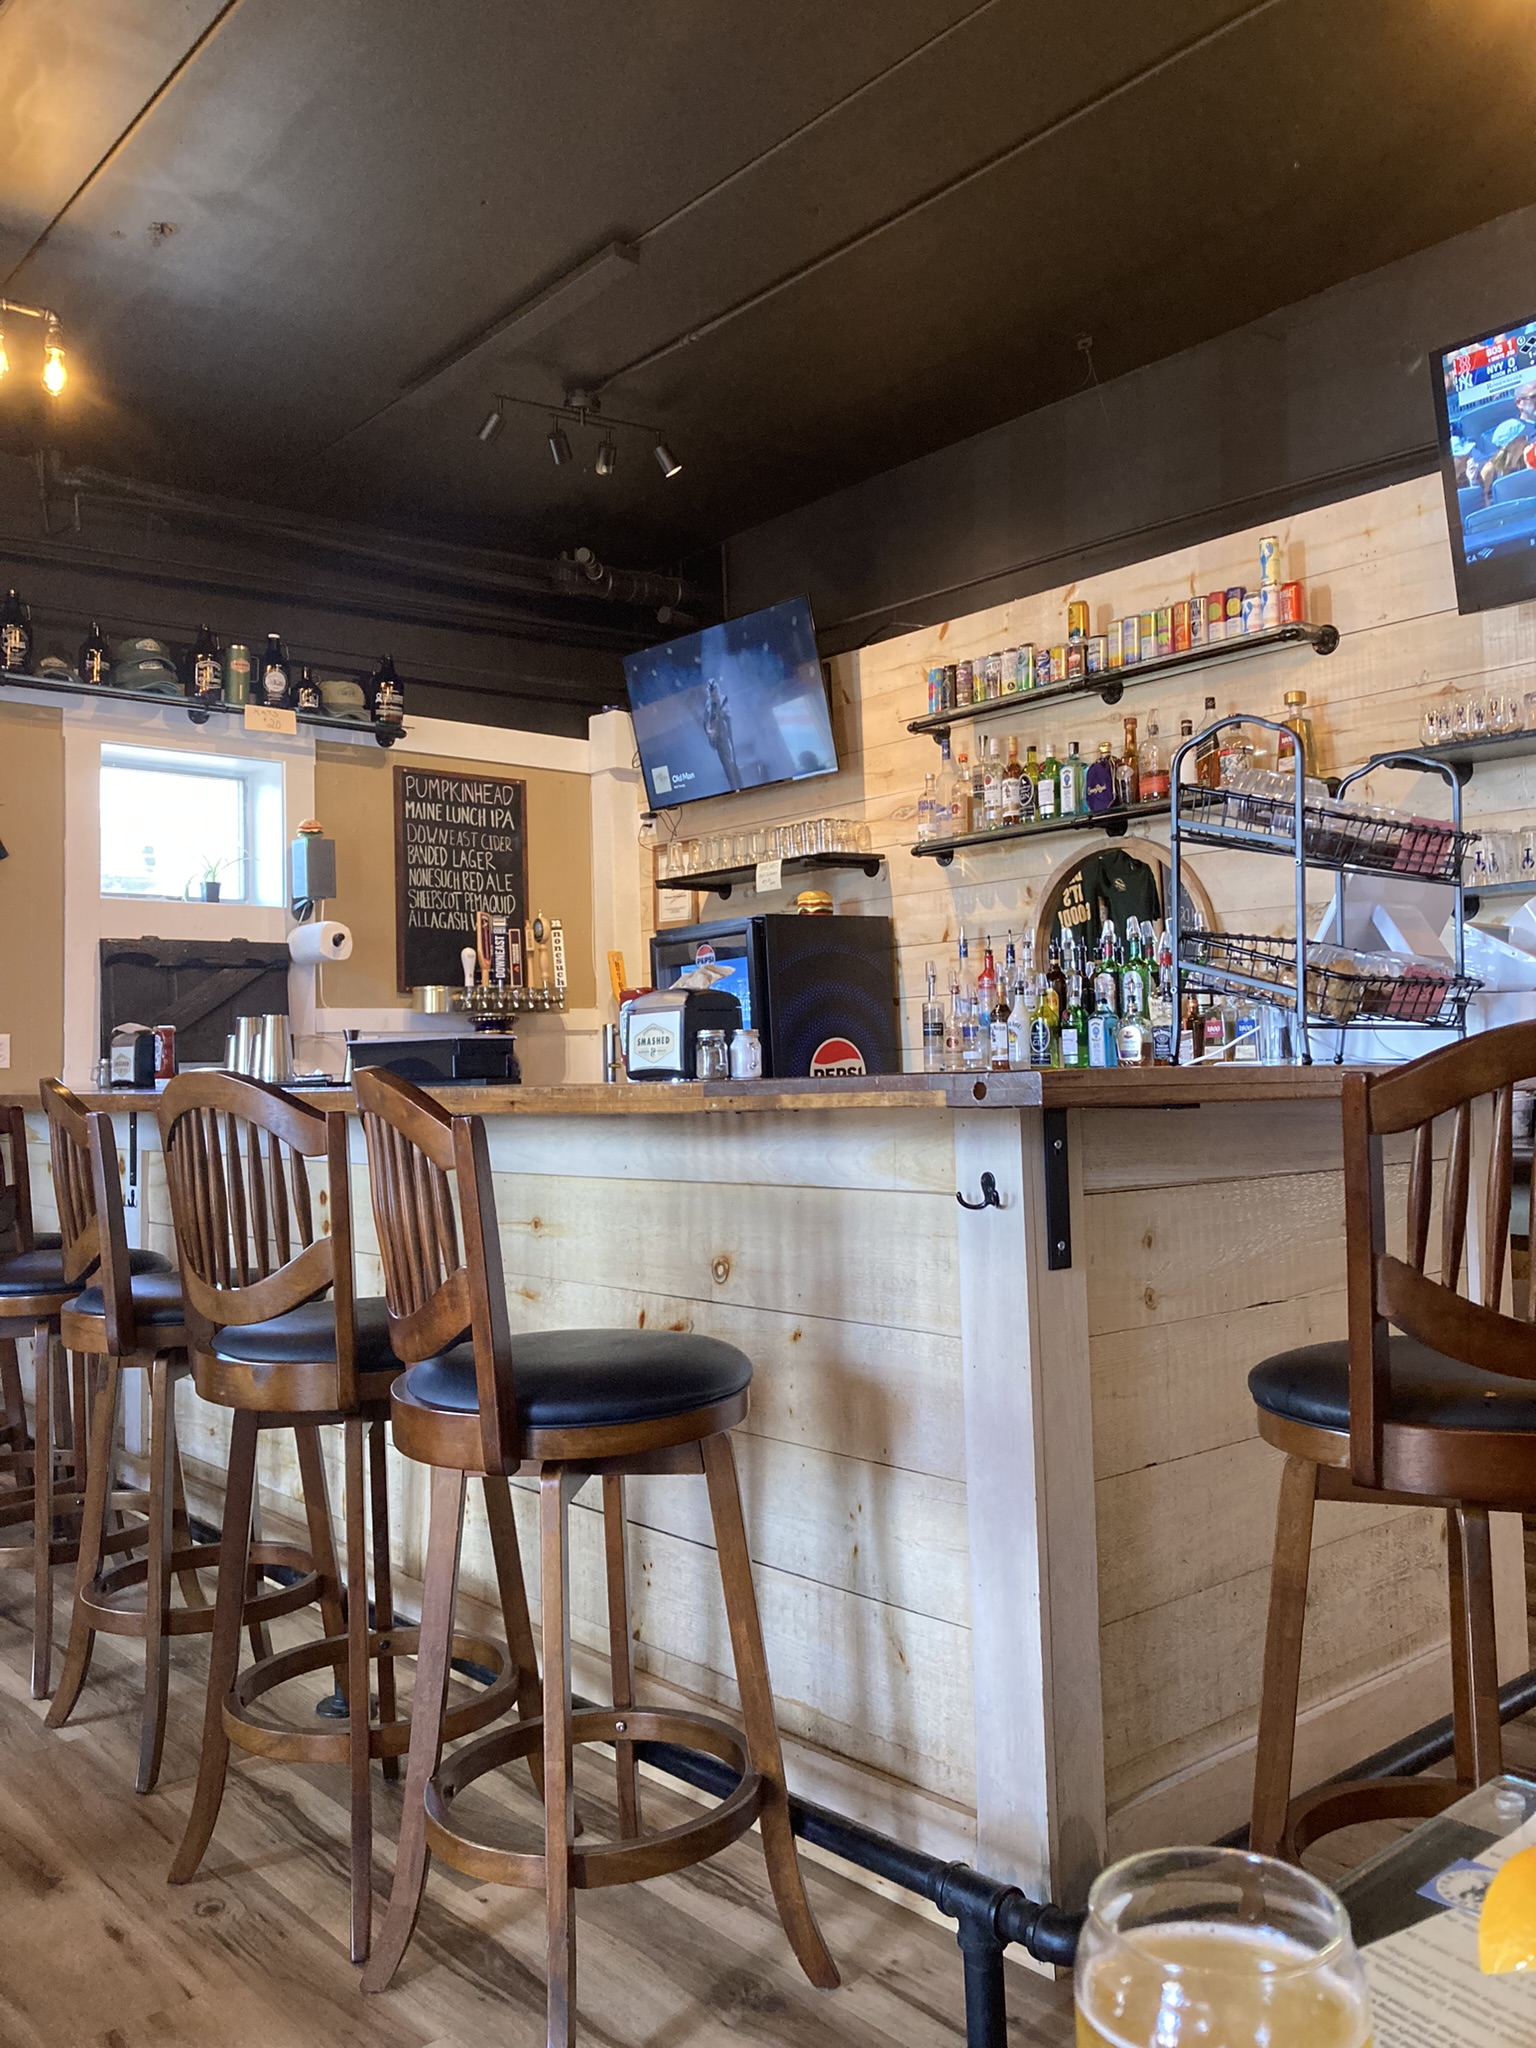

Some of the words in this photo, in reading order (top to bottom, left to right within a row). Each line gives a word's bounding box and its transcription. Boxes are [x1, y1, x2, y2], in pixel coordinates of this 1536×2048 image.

[1486, 344, 1503, 357] BOS
[1486, 361, 1504, 375] NYY
[1507, 357, 1516, 368] 0
[405, 775, 514, 806] PUMPKINHEAD
[404, 800, 443, 822] MAINE
[445, 804, 487, 828] LUNCH
[490, 807, 515, 831] IPA
[406, 823, 479, 848] DOWNEAST
[480, 832, 513, 852] CIDER
[407, 844, 448, 868] BANDED
[452, 849, 497, 871] LAGER
[408, 868, 460, 890] NONESUCH
[462, 871, 484, 892] RED
[485, 873, 514, 892] ALE
[407, 889, 463, 911] SHEEPSCOT
[464, 892, 516, 915] PEMAQUID
[408, 909, 469, 932] ALLAGASH
[494, 935, 506, 979] DOWNEAST
[553, 931, 565, 986] nonesuch
[697, 956, 715, 965] PEPSI
[637, 1036, 670, 1047] SMASHED
[814, 1066, 862, 1077] PEPSI
